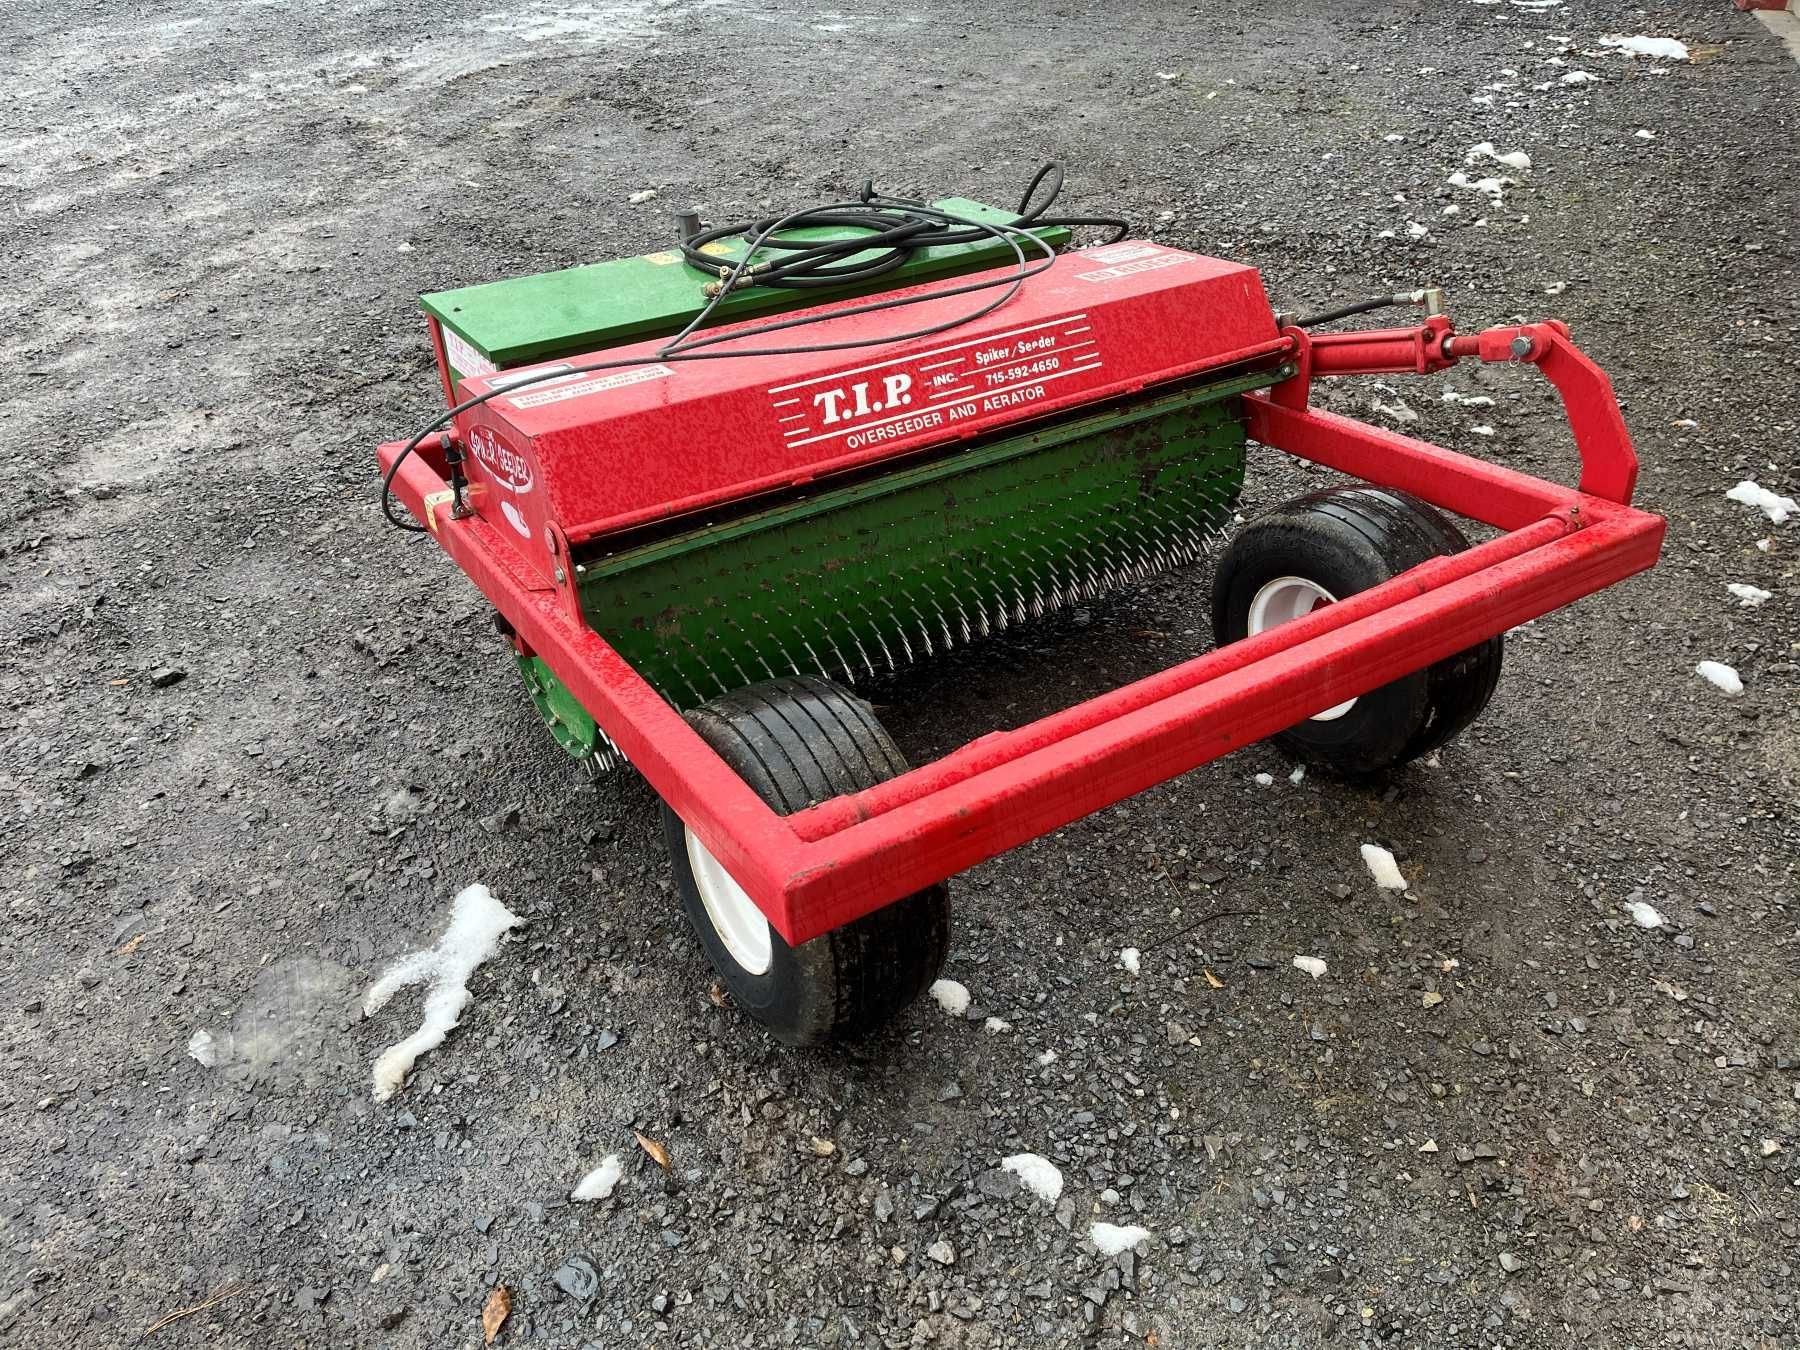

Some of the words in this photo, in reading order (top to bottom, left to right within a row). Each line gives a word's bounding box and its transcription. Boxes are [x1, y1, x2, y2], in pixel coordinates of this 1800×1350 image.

[985, 357, 1060, 386] 715-592-4650
[847, 413, 943, 449] OVERSEEDER
[949, 404, 977, 422] AND
[983, 386, 1046, 413] AERATOR
